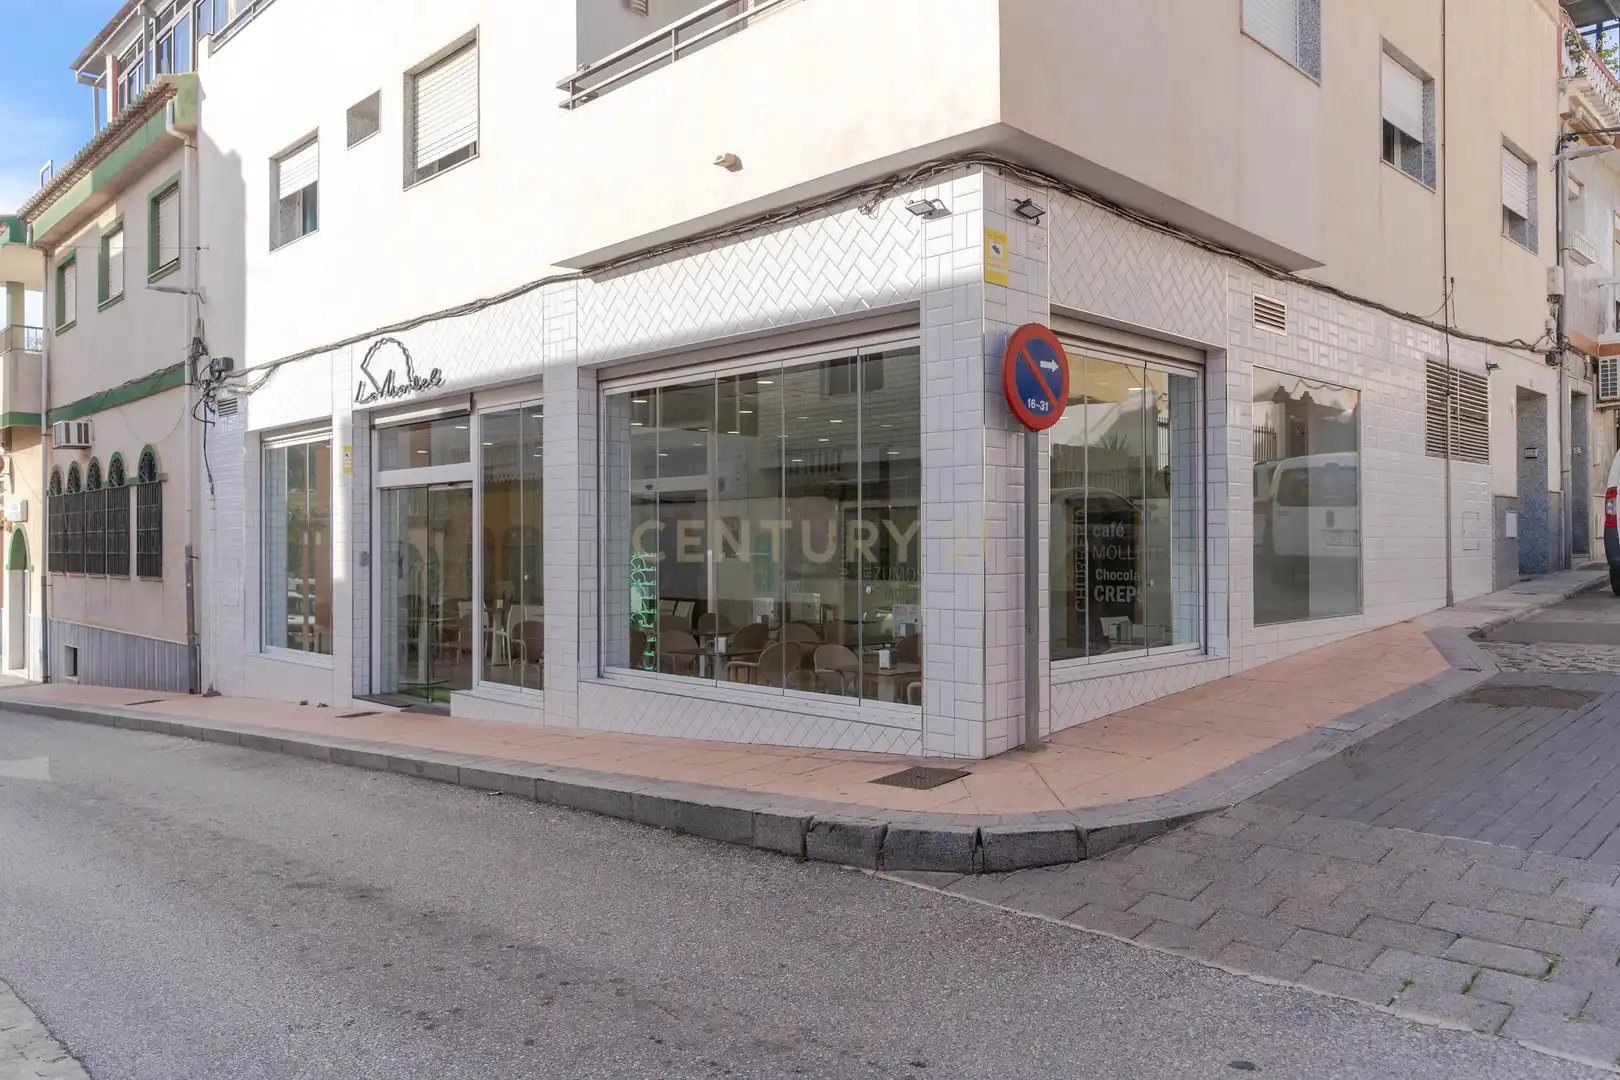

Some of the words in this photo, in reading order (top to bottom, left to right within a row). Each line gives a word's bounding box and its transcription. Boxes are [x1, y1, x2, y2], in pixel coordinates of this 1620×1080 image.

[1027, 398, 1049, 411] 16-31
[1092, 520, 1125, 538] café
[1095, 568, 1140, 581] Chocola
